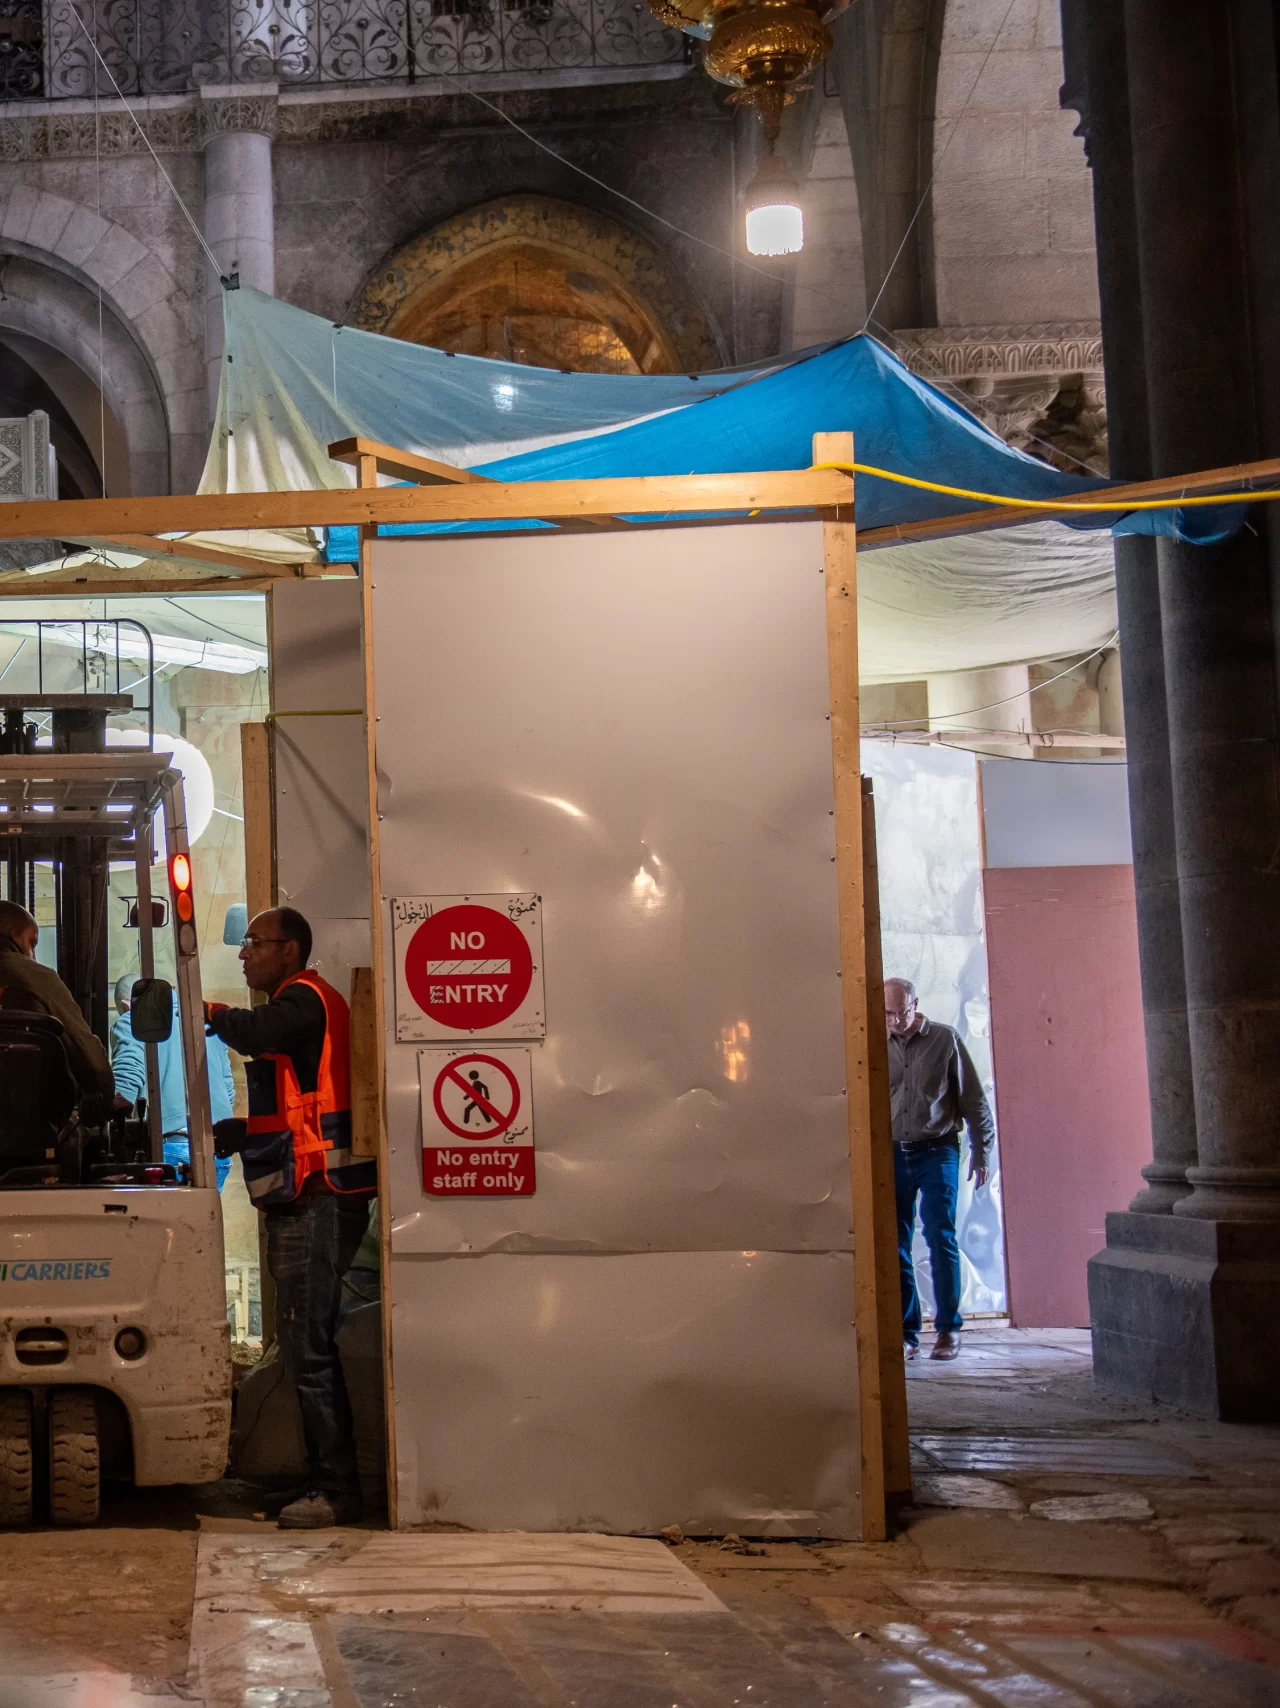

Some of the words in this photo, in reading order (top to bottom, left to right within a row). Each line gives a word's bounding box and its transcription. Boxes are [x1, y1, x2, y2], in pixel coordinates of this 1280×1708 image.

[450, 931, 485, 950] NO
[429, 984, 508, 1004] ENTRY
[437, 1150, 463, 1166] No
[469, 1150, 519, 1169] entry
[433, 1172, 477, 1188] staff
[483, 1172, 525, 1191] only
